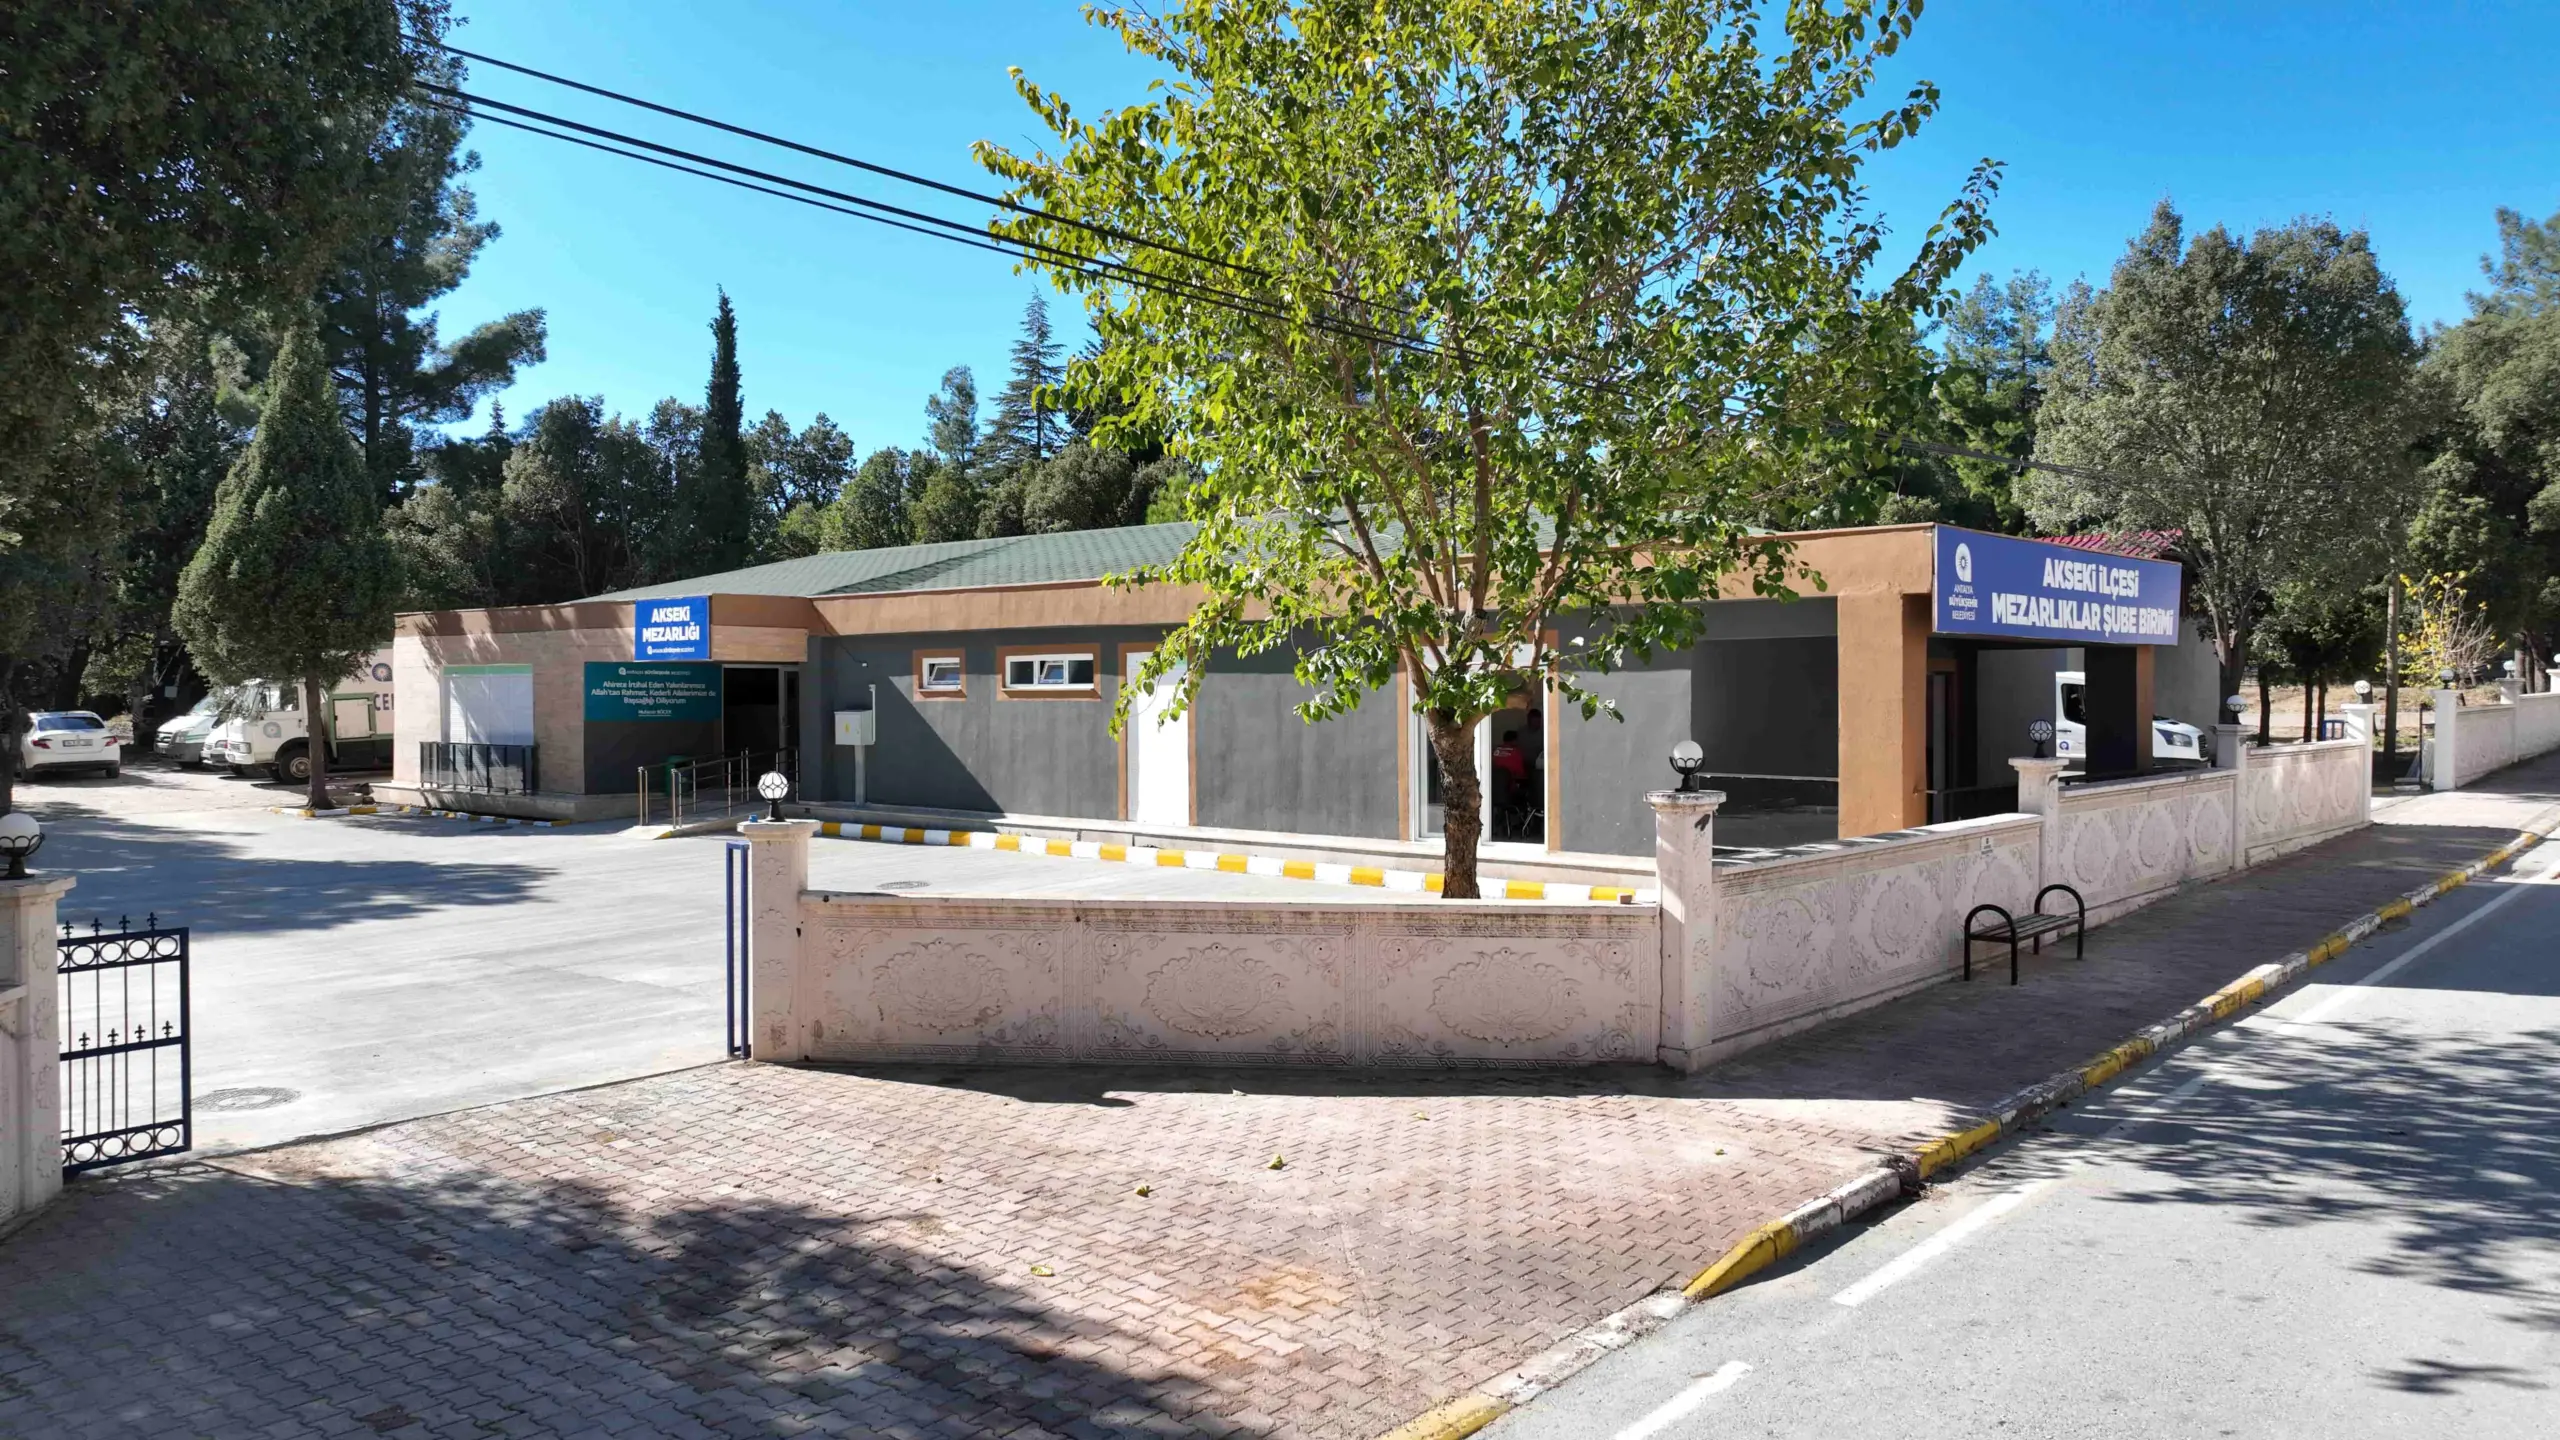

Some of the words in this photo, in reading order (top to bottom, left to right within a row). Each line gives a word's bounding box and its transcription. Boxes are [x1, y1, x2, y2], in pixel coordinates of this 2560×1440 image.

[1953, 583, 1974, 594] ANTALYA
[2042, 557, 2097, 593] AKSEKİ
[2098, 564, 2140, 602] İLÇESİ
[651, 605, 691, 624] AKSEKİ
[1991, 592, 2101, 632] MEZARLIKLAR
[2102, 605, 2137, 638] ŞUBE
[2138, 607, 2174, 636] BİRİMİ
[642, 621, 700, 643] MEZARLIĞI
